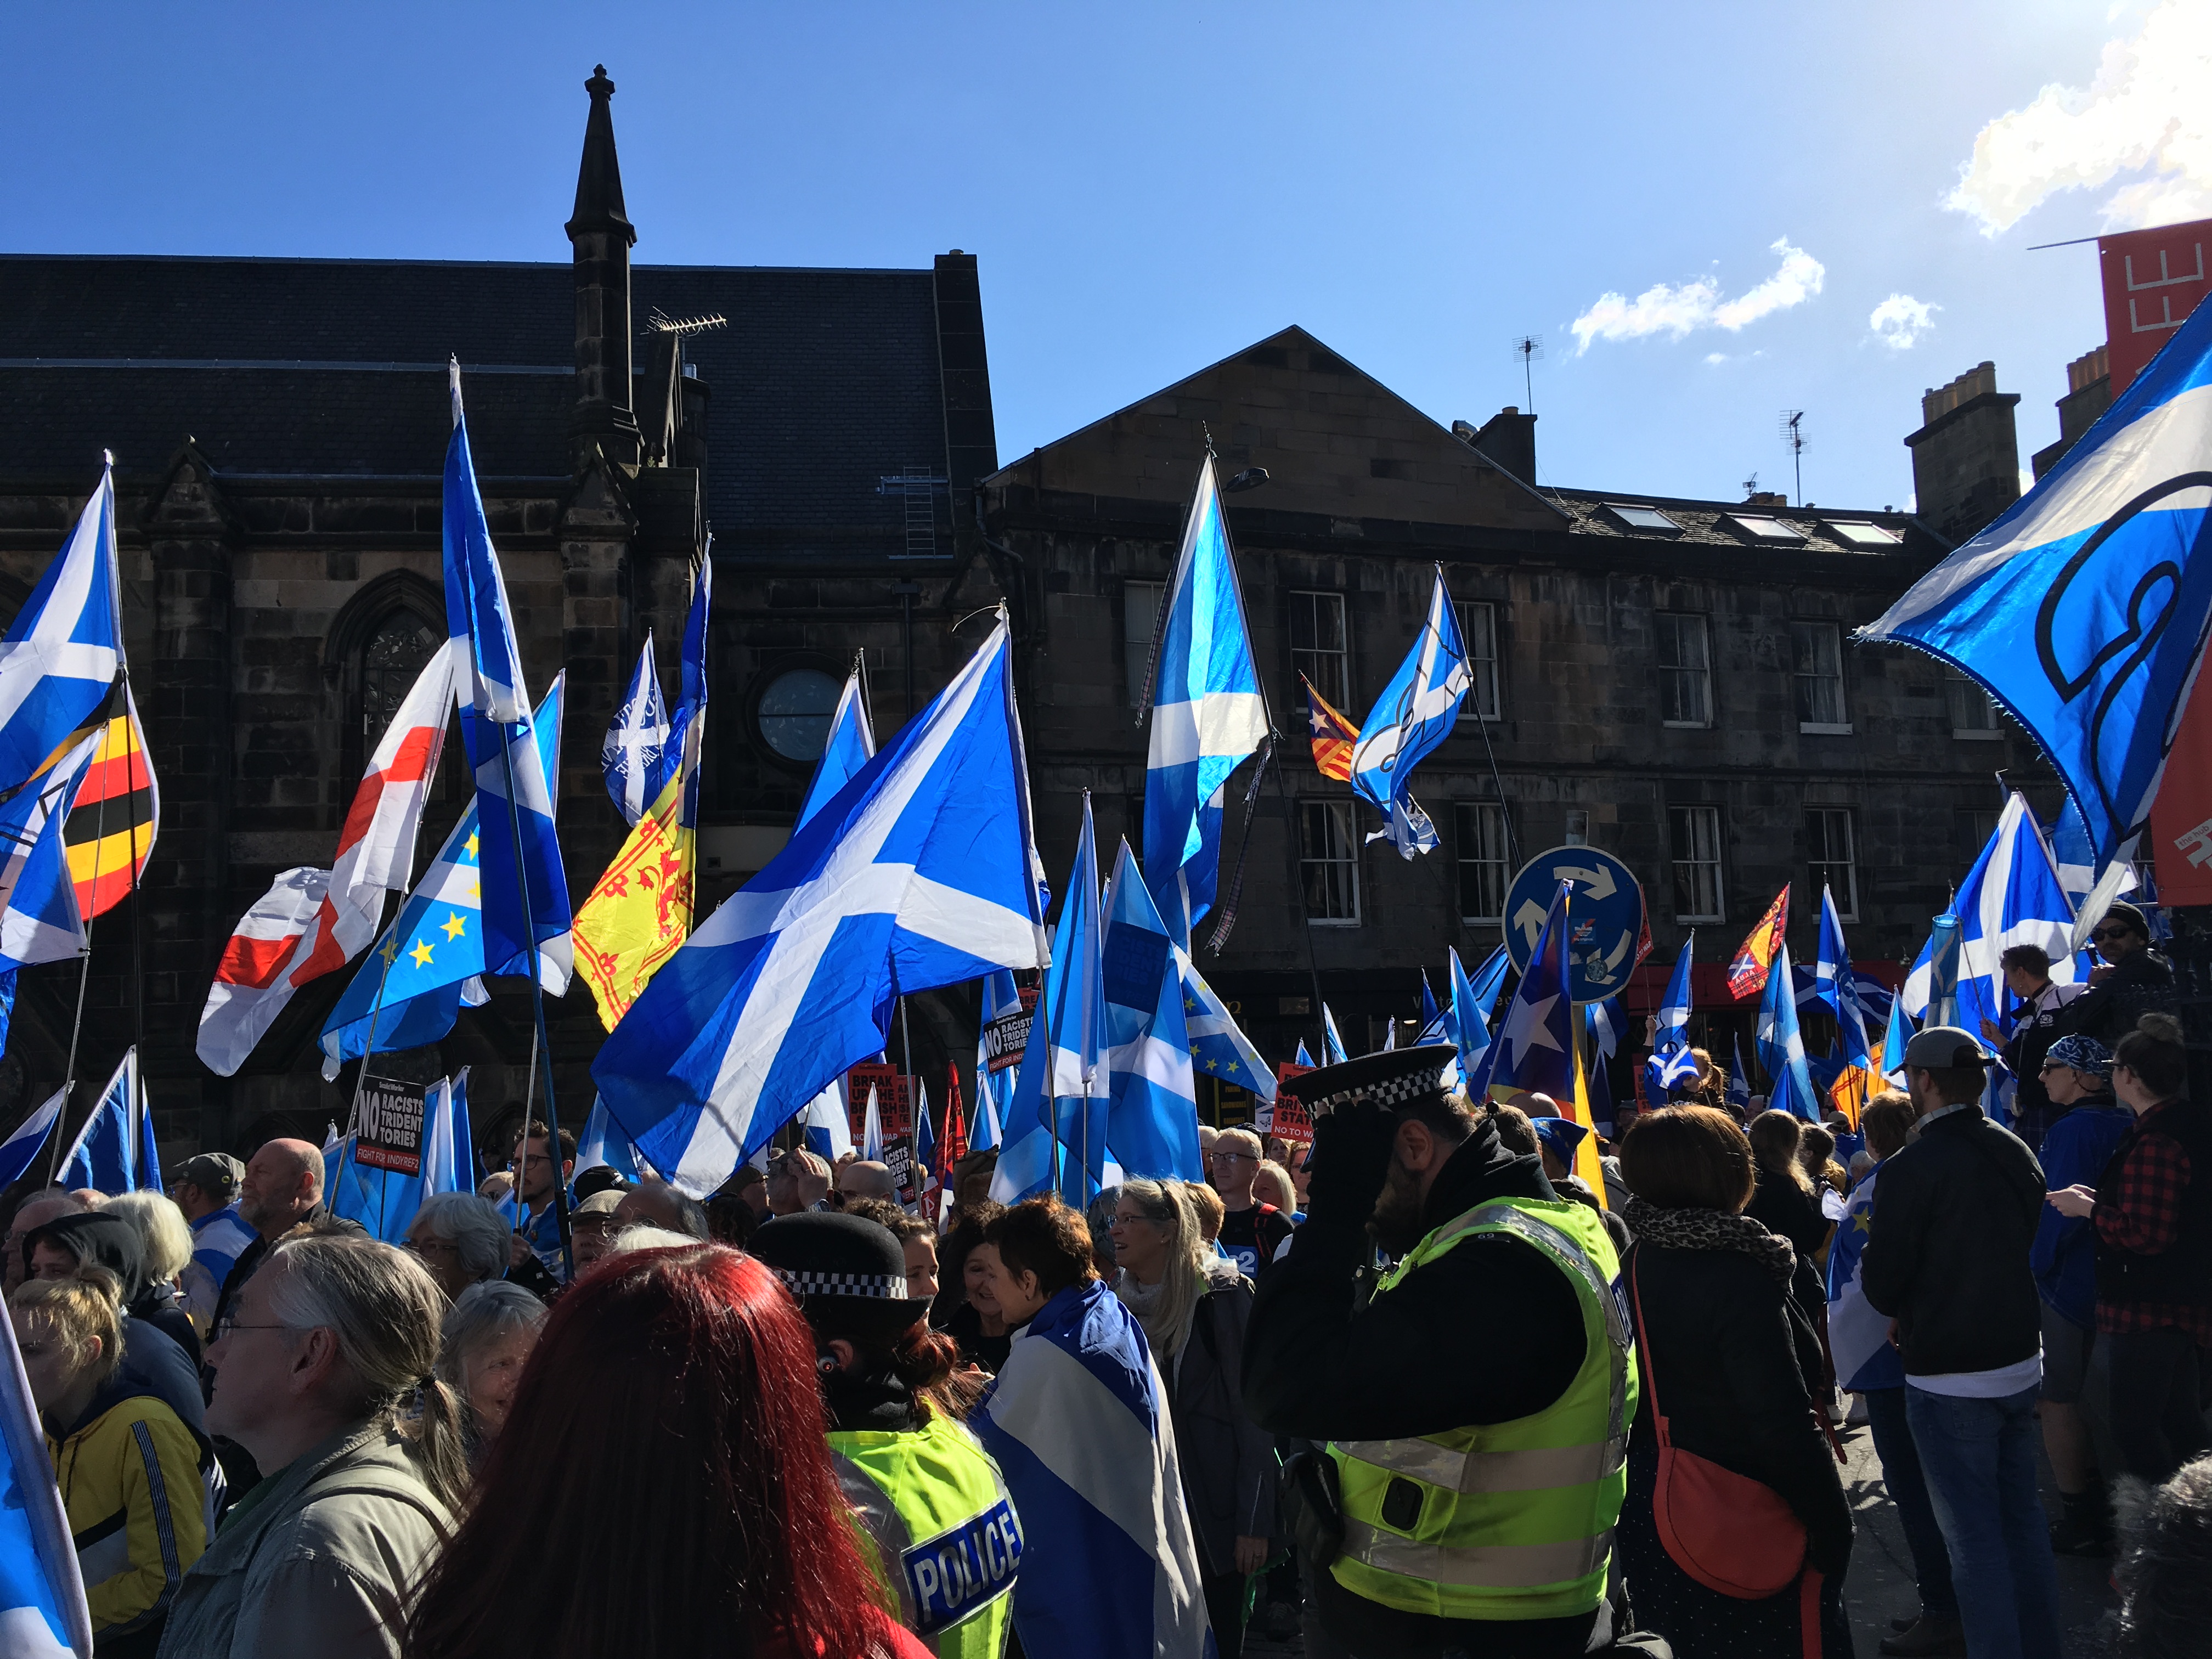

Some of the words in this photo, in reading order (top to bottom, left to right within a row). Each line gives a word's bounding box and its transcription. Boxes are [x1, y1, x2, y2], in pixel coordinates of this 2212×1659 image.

[2178, 836, 2193, 847] the
[2192, 826, 2209, 838] hub
[985, 1028, 1002, 1058] NO
[1002, 1026, 1031, 1042] TRIDEN
[1003, 1037, 1027, 1052] TORIE
[989, 1059, 1002, 1070] FIGHT
[1002, 1056, 1012, 1065] FOR
[853, 1075, 892, 1087] BREAK
[382, 1093, 424, 1115] RACISTS
[853, 1088, 868, 1100] UP
[879, 1088, 894, 1101] HE
[358, 1090, 380, 1140] NO
[381, 1110, 423, 1132] TRIDENT
[380, 1127, 415, 1148] TORIES
[1274, 1126, 1287, 1134] NO
[357, 1148, 375, 1160] FIGHT
[375, 1152, 386, 1163] FOR
[387, 1154, 419, 1169] INDYREF2
[885, 1146, 908, 1165] ACISTS
[914, 1511, 1020, 1622] POLICE
